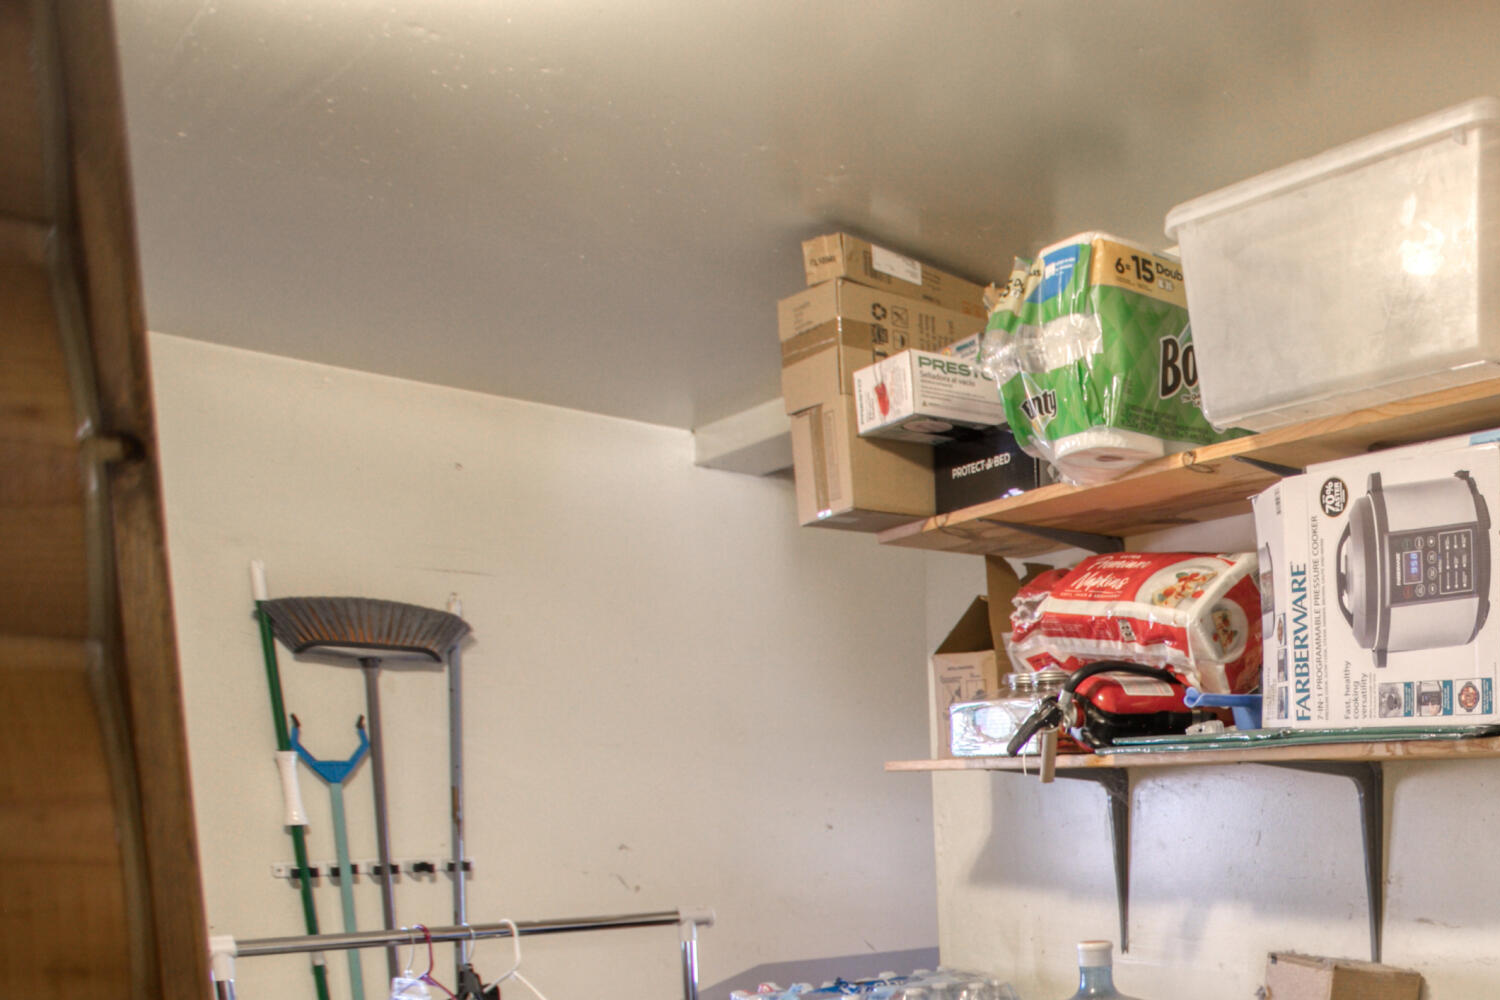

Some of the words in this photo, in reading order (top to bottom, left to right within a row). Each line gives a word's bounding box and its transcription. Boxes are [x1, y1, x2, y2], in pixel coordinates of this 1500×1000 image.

[1325, 481, 1335, 514] 70%
[1334, 481, 1342, 513] FASTER
[1310, 515, 1319, 556] COOKER
[1070, 571, 1130, 592] Napkins
[1311, 558, 1322, 606] PRESSURE
[1291, 564, 1311, 721] FARBERWARE
[1313, 609, 1324, 690] PROGRAMMABLE
[1343, 660, 1352, 697] healthy
[1361, 672, 1369, 719] versatility
[1343, 700, 1351, 720] Fast,
[1352, 681, 1361, 719] cooking
